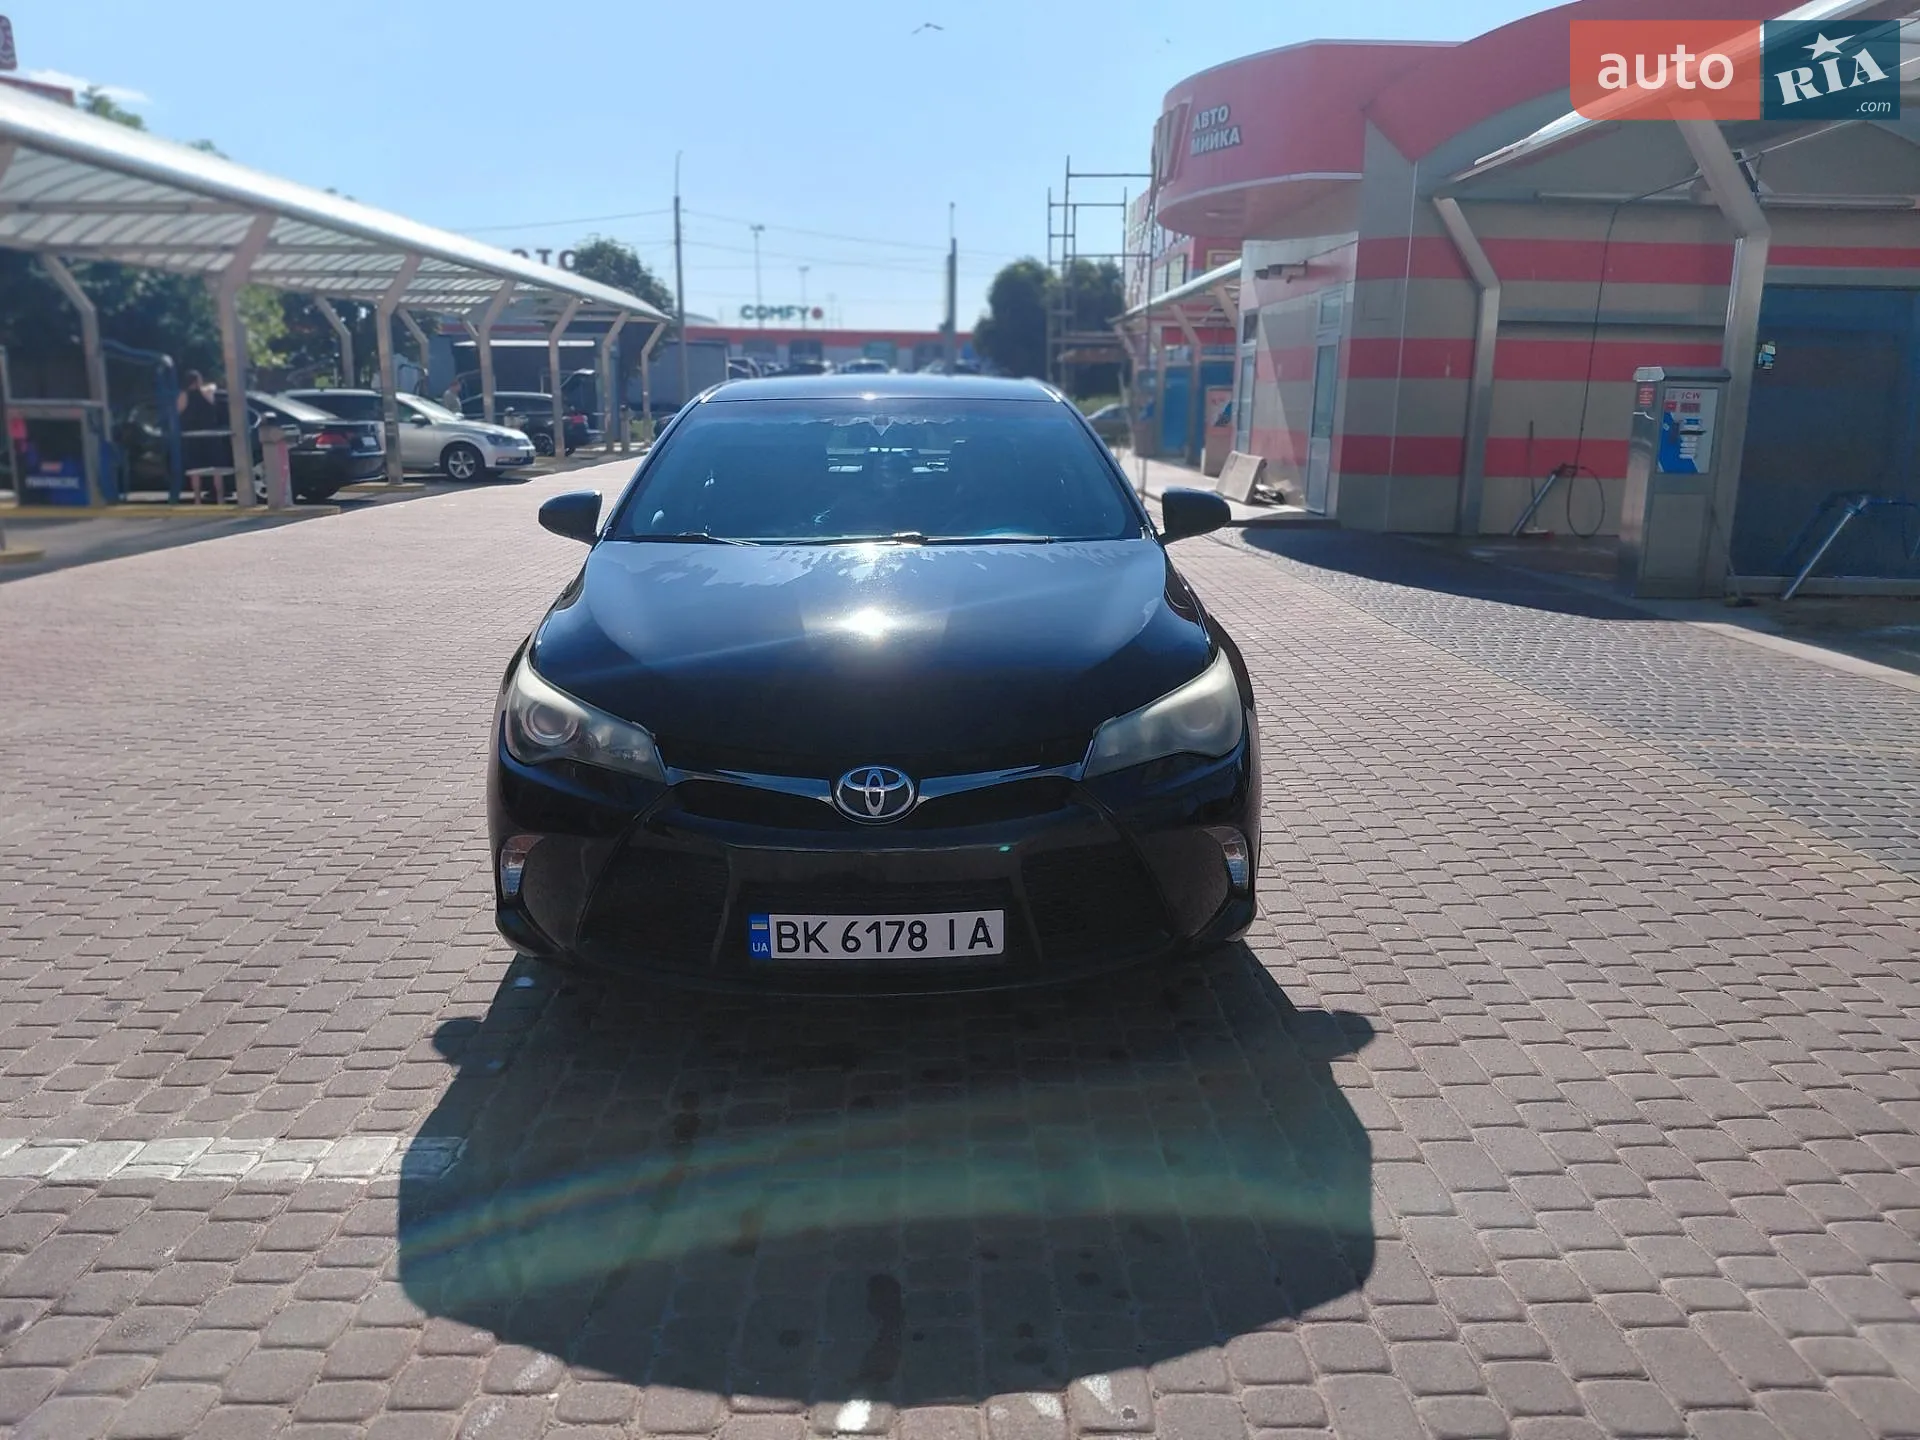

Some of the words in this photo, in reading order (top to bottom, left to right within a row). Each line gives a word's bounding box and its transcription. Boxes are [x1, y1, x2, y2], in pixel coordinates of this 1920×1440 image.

[1192, 105, 1229, 131] АВТО
[1190, 126, 1241, 155] МИЙКА
[740, 304, 809, 320] COMFY
[752, 942, 769, 953] UA
[776, 920, 829, 954] BK
[841, 920, 928, 953] 6178
